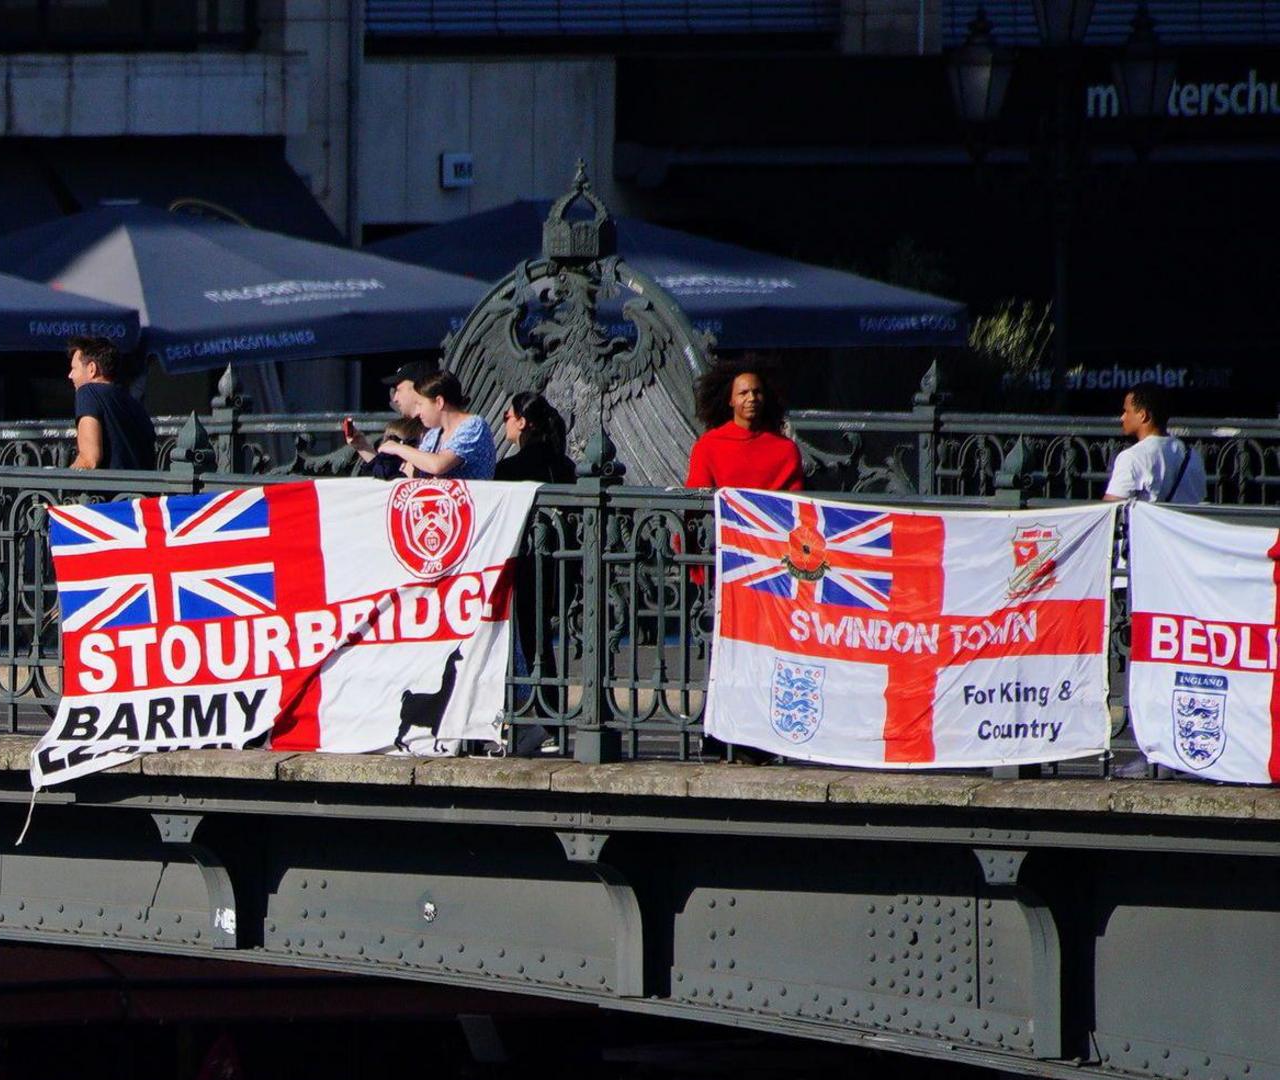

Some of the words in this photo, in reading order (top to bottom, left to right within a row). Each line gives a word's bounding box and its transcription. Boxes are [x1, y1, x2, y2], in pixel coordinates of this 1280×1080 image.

[789, 609, 940, 655] SWINDON
[950, 610, 1040, 654] TOWN
[963, 682, 995, 705] For
[1000, 681, 1049, 707] King
[1058, 680, 1072, 701] &
[1179, 675, 1224, 688] ENGLAND
[57, 689, 268, 741] BARMY
[977, 718, 1063, 743] Country
